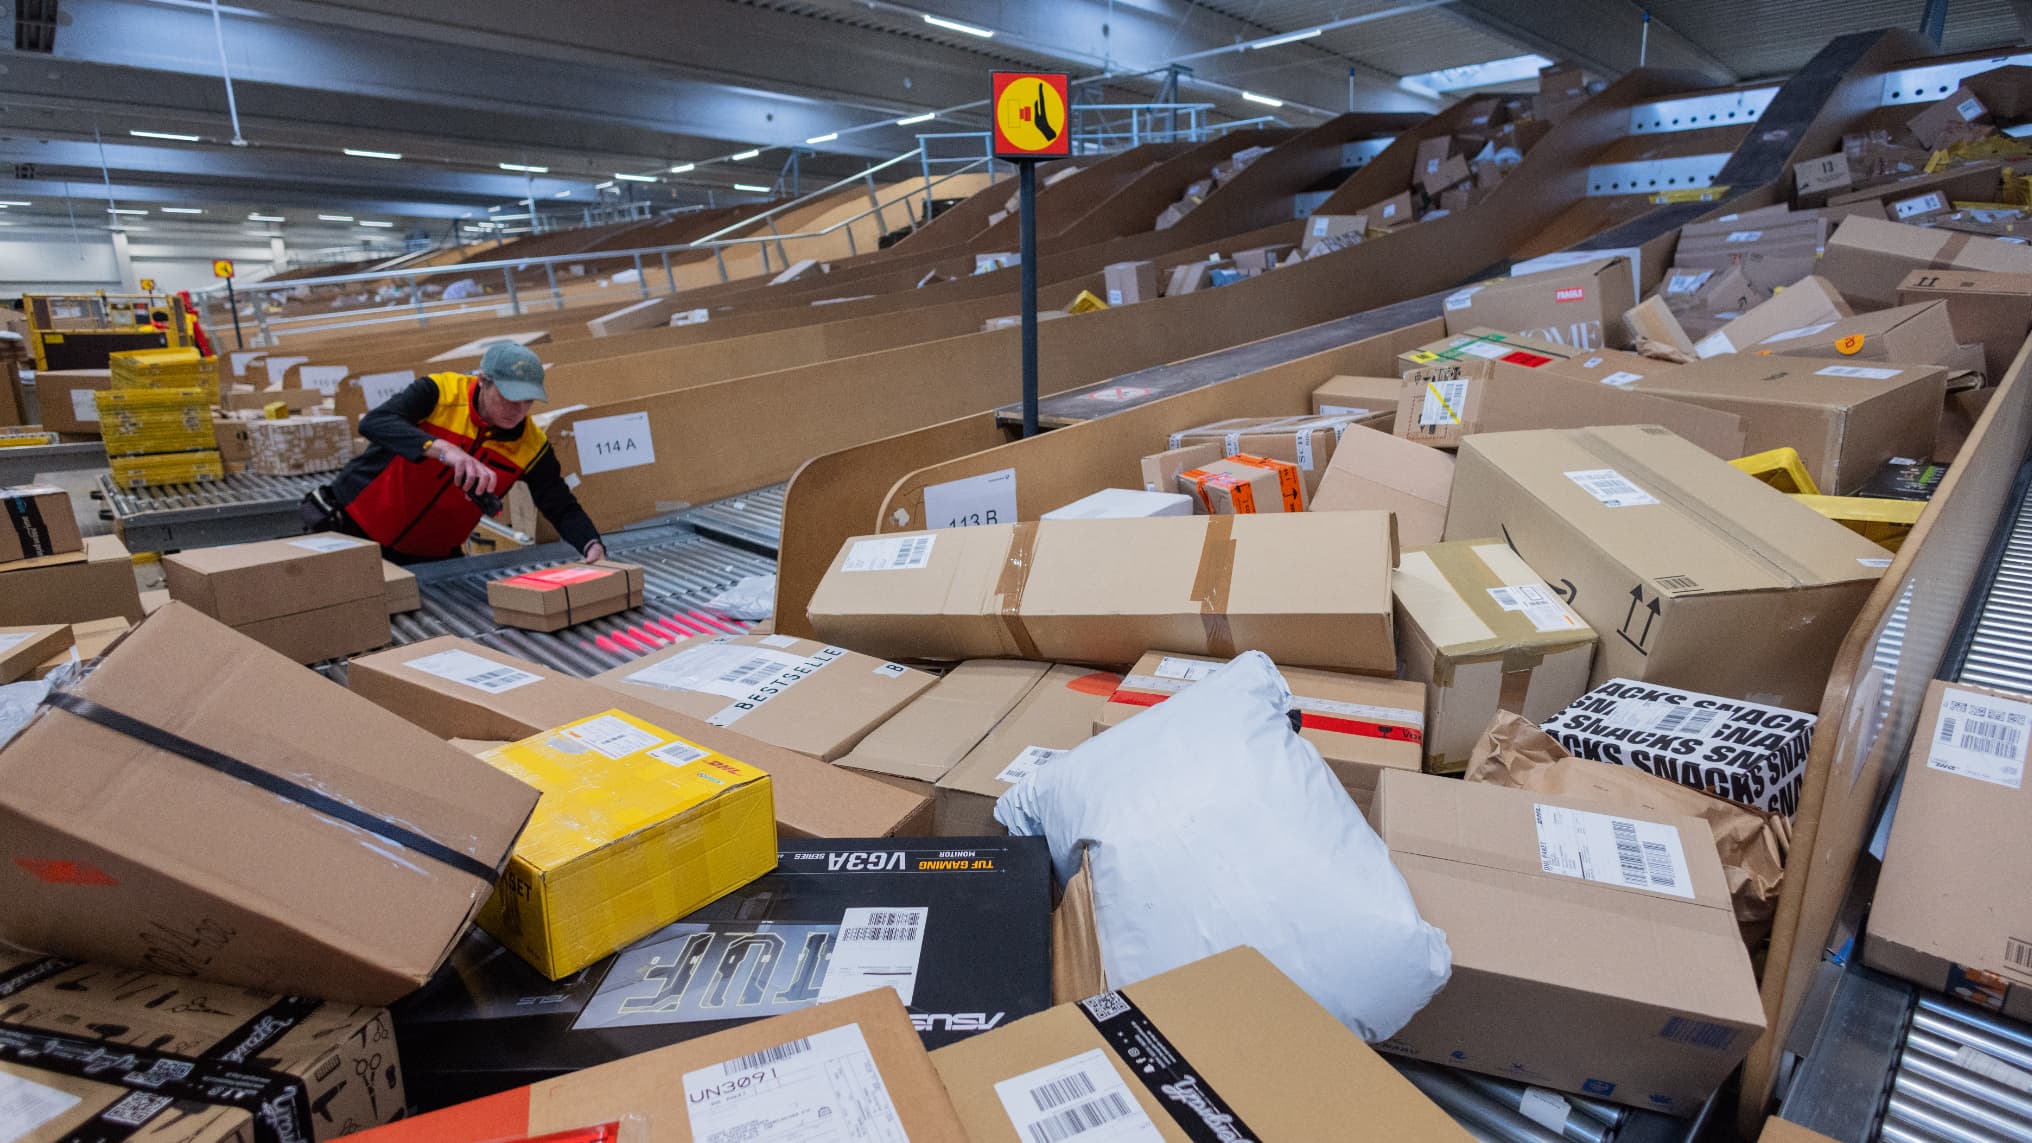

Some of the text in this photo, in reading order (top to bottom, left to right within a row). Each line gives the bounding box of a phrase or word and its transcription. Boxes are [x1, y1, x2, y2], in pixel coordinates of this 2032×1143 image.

[595, 437, 637, 456] 114 A
[949, 513, 980, 528] 113
[828, 852, 906, 871] VG3A
[918, 859, 993, 870] TUF GAMING
[617, 932, 830, 1014] TUF
[908, 1012, 1006, 1032] ASUS
